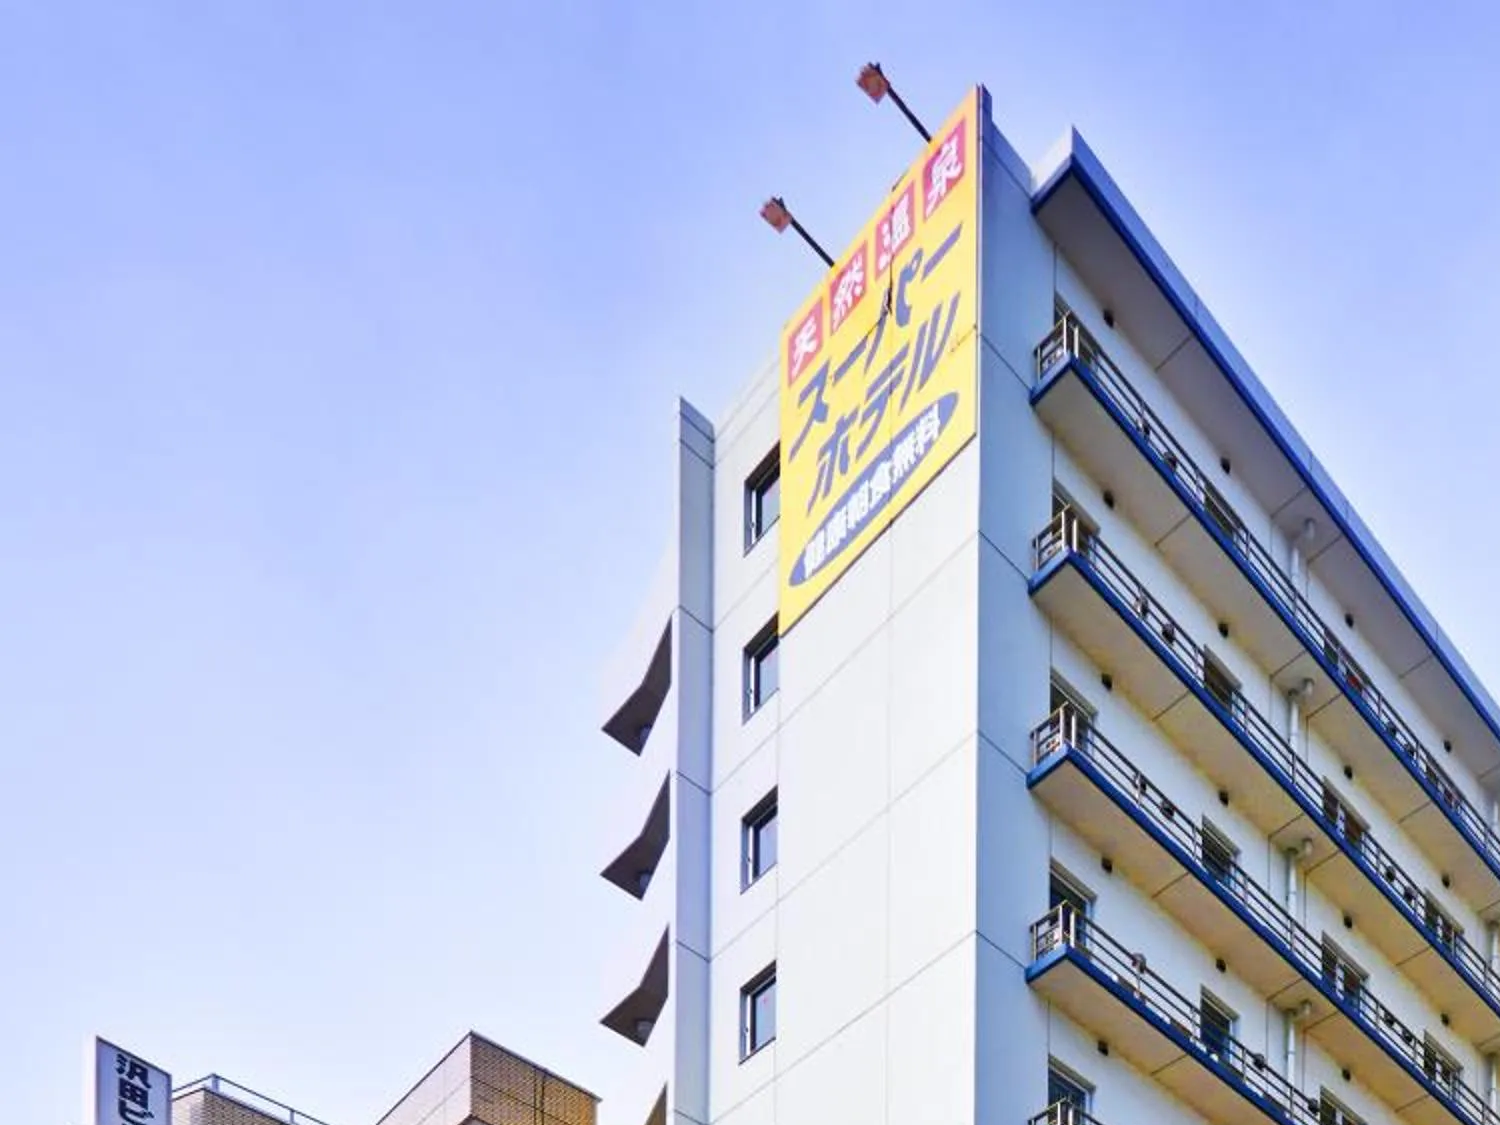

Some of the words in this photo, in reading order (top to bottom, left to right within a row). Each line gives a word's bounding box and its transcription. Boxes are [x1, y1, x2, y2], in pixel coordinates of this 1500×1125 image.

[788, 221, 963, 464] スーパー
[790, 135, 963, 380] 天然温泉
[807, 291, 961, 516] ホテル
